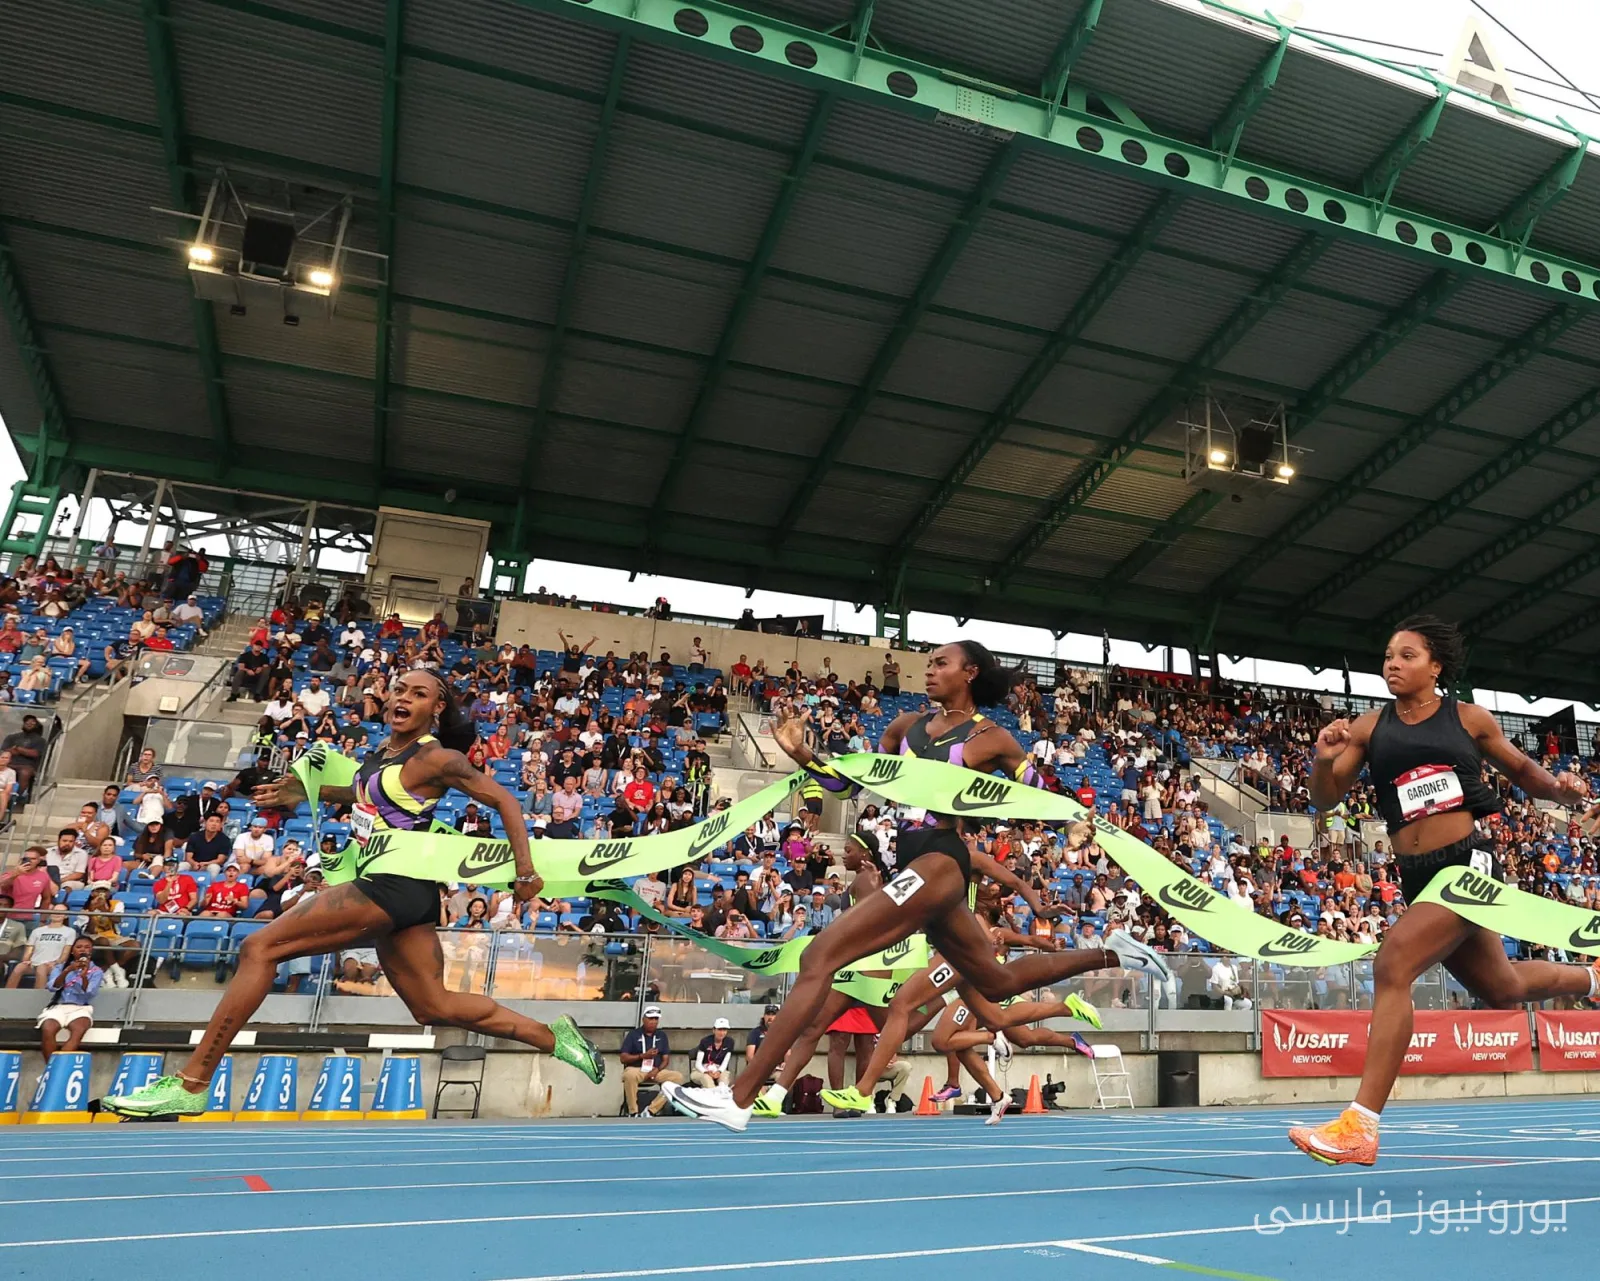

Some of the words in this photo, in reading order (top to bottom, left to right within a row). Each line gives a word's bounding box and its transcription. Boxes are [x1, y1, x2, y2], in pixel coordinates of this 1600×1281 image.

[1446, 14, 1525, 122] A
[868, 758, 904, 779] RUN
[966, 777, 1012, 803] RUN
[1407, 778, 1449, 801] GARDNER
[698, 812, 730, 841] RUN
[470, 842, 513, 863] RUN
[590, 842, 633, 859] RUN
[892, 875, 918, 899] 4
[1171, 878, 1216, 907] RUN
[1455, 871, 1503, 904] RUN
[40, 933, 63, 941] DUKE
[1274, 932, 1320, 951] RUN
[754, 948, 783, 963] RUN
[933, 966, 951, 984] 6
[955, 1008, 967, 1023] 8
[1296, 1033, 1350, 1049] USATF
[1408, 1033, 1437, 1048] ATF
[1474, 1032, 1519, 1047] USATF
[1565, 1032, 1600, 1045] USAT
[1292, 1055, 1310, 1063] NEW
[1310, 1055, 1332, 1063] YORK
[1403, 1054, 1423, 1063] YORK
[1472, 1053, 1488, 1061] NEW
[1488, 1052, 1507, 1060] YORK
[1564, 1051, 1580, 1059] NEW
[5, 1072, 19, 1103] 7
[35, 1071, 49, 1103] 6
[66, 1070, 84, 1103] 6
[214, 1073, 226, 1103] 4
[250, 1073, 265, 1103] 3
[280, 1073, 291, 1103] 3
[313, 1073, 328, 1102] 2
[340, 1073, 353, 1102] 2
[380, 1073, 389, 1103] 1
[408, 1073, 416, 1102] 1
